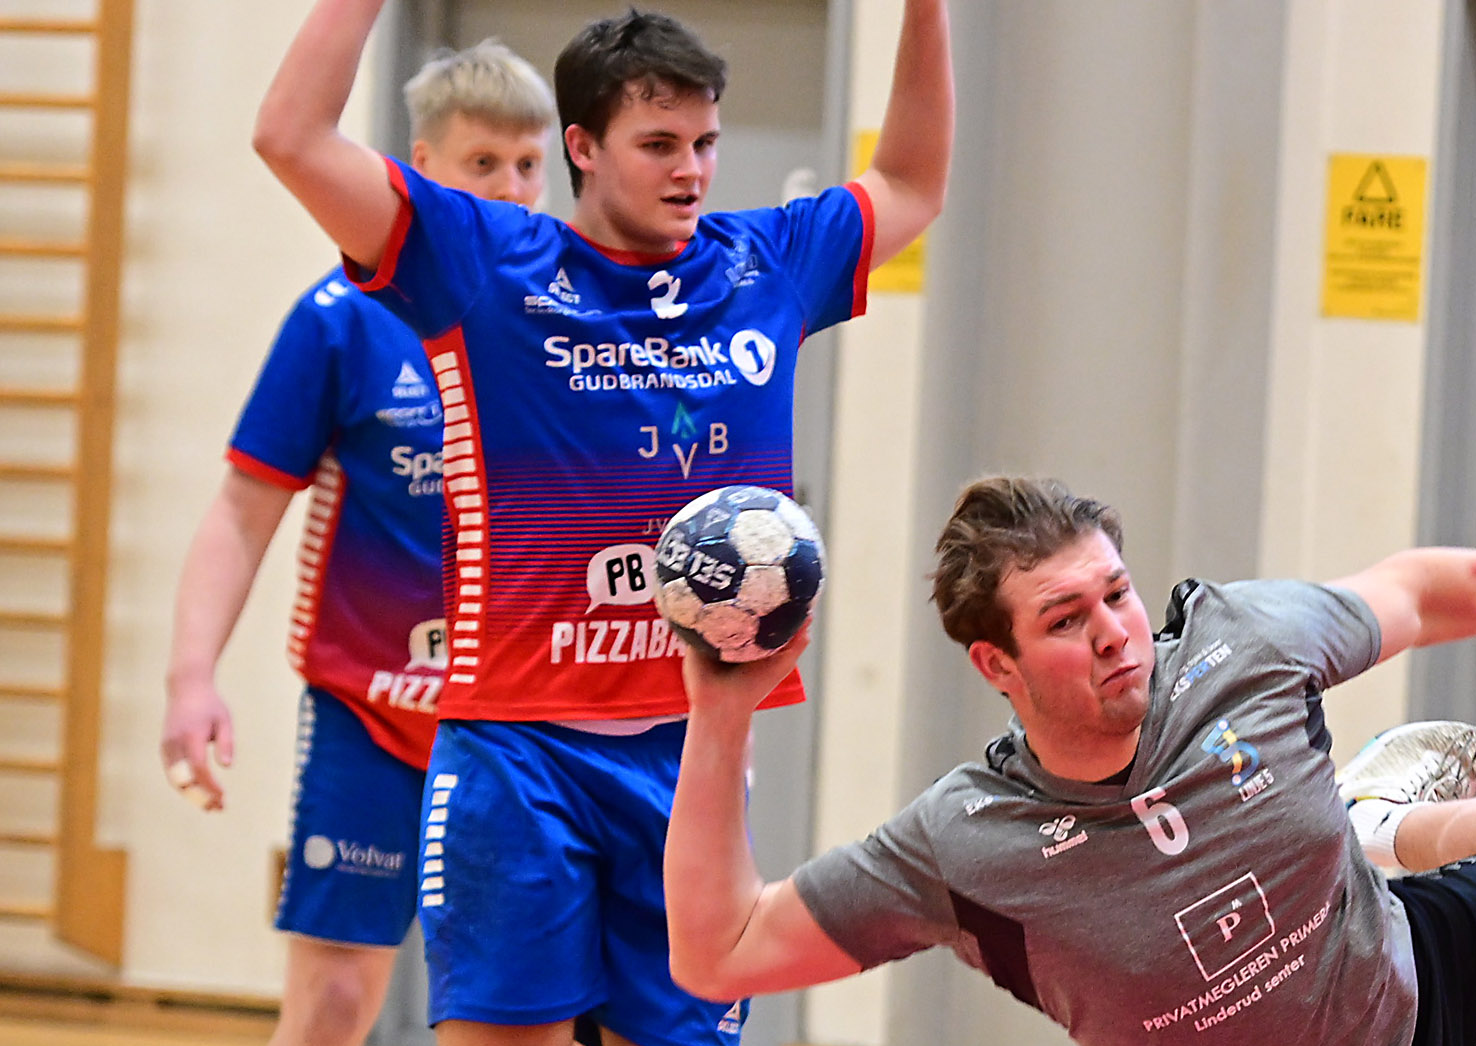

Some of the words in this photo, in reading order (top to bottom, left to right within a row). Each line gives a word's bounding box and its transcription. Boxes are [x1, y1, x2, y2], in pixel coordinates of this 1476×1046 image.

[647, 270, 688, 319] 2
[543, 335, 728, 373] SpareBank
[569, 369, 737, 391] GUDBRANDSDAL
[606, 553, 646, 597] PB
[1131, 786, 1189, 855] 6
[1216, 910, 1242, 943] P
[1143, 945, 1279, 1032] PRIVATMEGLEREN
[1193, 986, 1263, 1032] Linderud
[1264, 953, 1306, 992] senter
